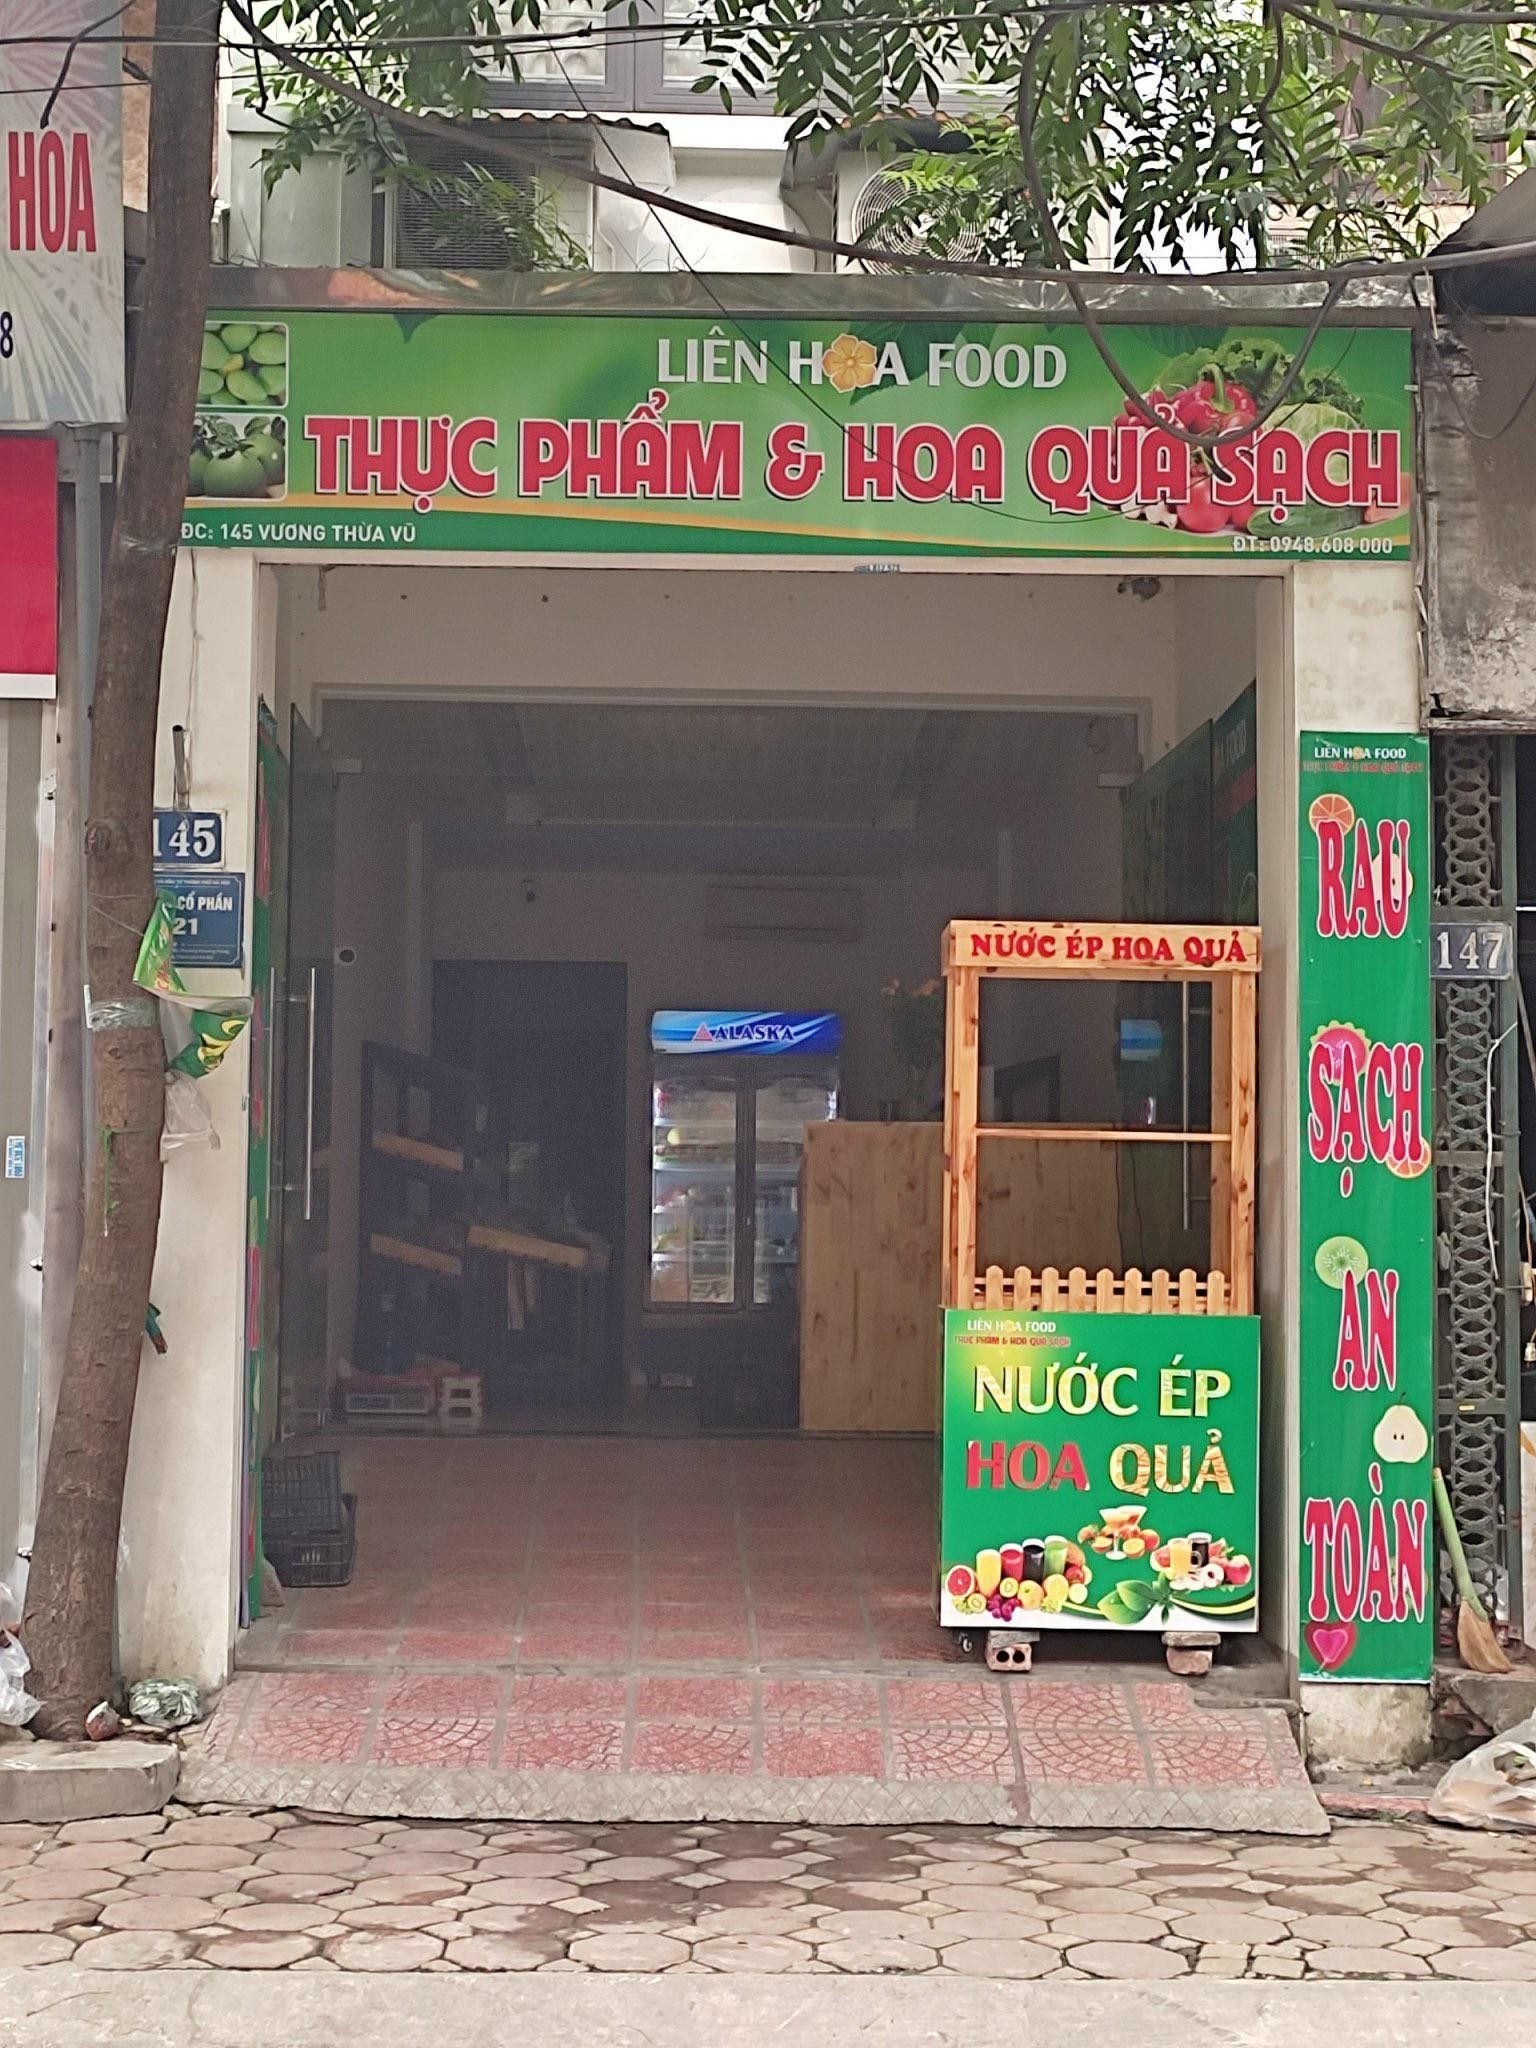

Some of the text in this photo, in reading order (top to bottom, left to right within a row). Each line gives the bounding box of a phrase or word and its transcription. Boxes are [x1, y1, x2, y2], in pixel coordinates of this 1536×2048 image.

[8, 131, 97, 253] HOA
[657, 325, 769, 386] LIÊN
[928, 343, 1068, 389] FOOD
[304, 388, 1401, 525] THỰC PHẨM & HOA QUẢ SẠCH
[180, 522, 416, 542] ĐC: 145 VƯƠNG THỪA VŨ
[1359, 538, 1392, 554] 000
[1375, 748, 1406, 759] FOOD
[1316, 818, 1410, 939] RAU
[971, 927, 1248, 964] NƯỚC ÉP HOA QUẢ
[1437, 931, 1504, 970] 147
[715, 1024, 795, 1042] ALASKA
[1308, 1042, 1423, 1198] SẠCH
[1025, 1321, 1057, 1333] FOOD
[1333, 1268, 1399, 1391] AN
[974, 1352, 1232, 1418] NƯỚC ÉP
[966, 1428, 1236, 1498] HOA QUẢ
[1304, 1463, 1427, 1623] TOÀN
